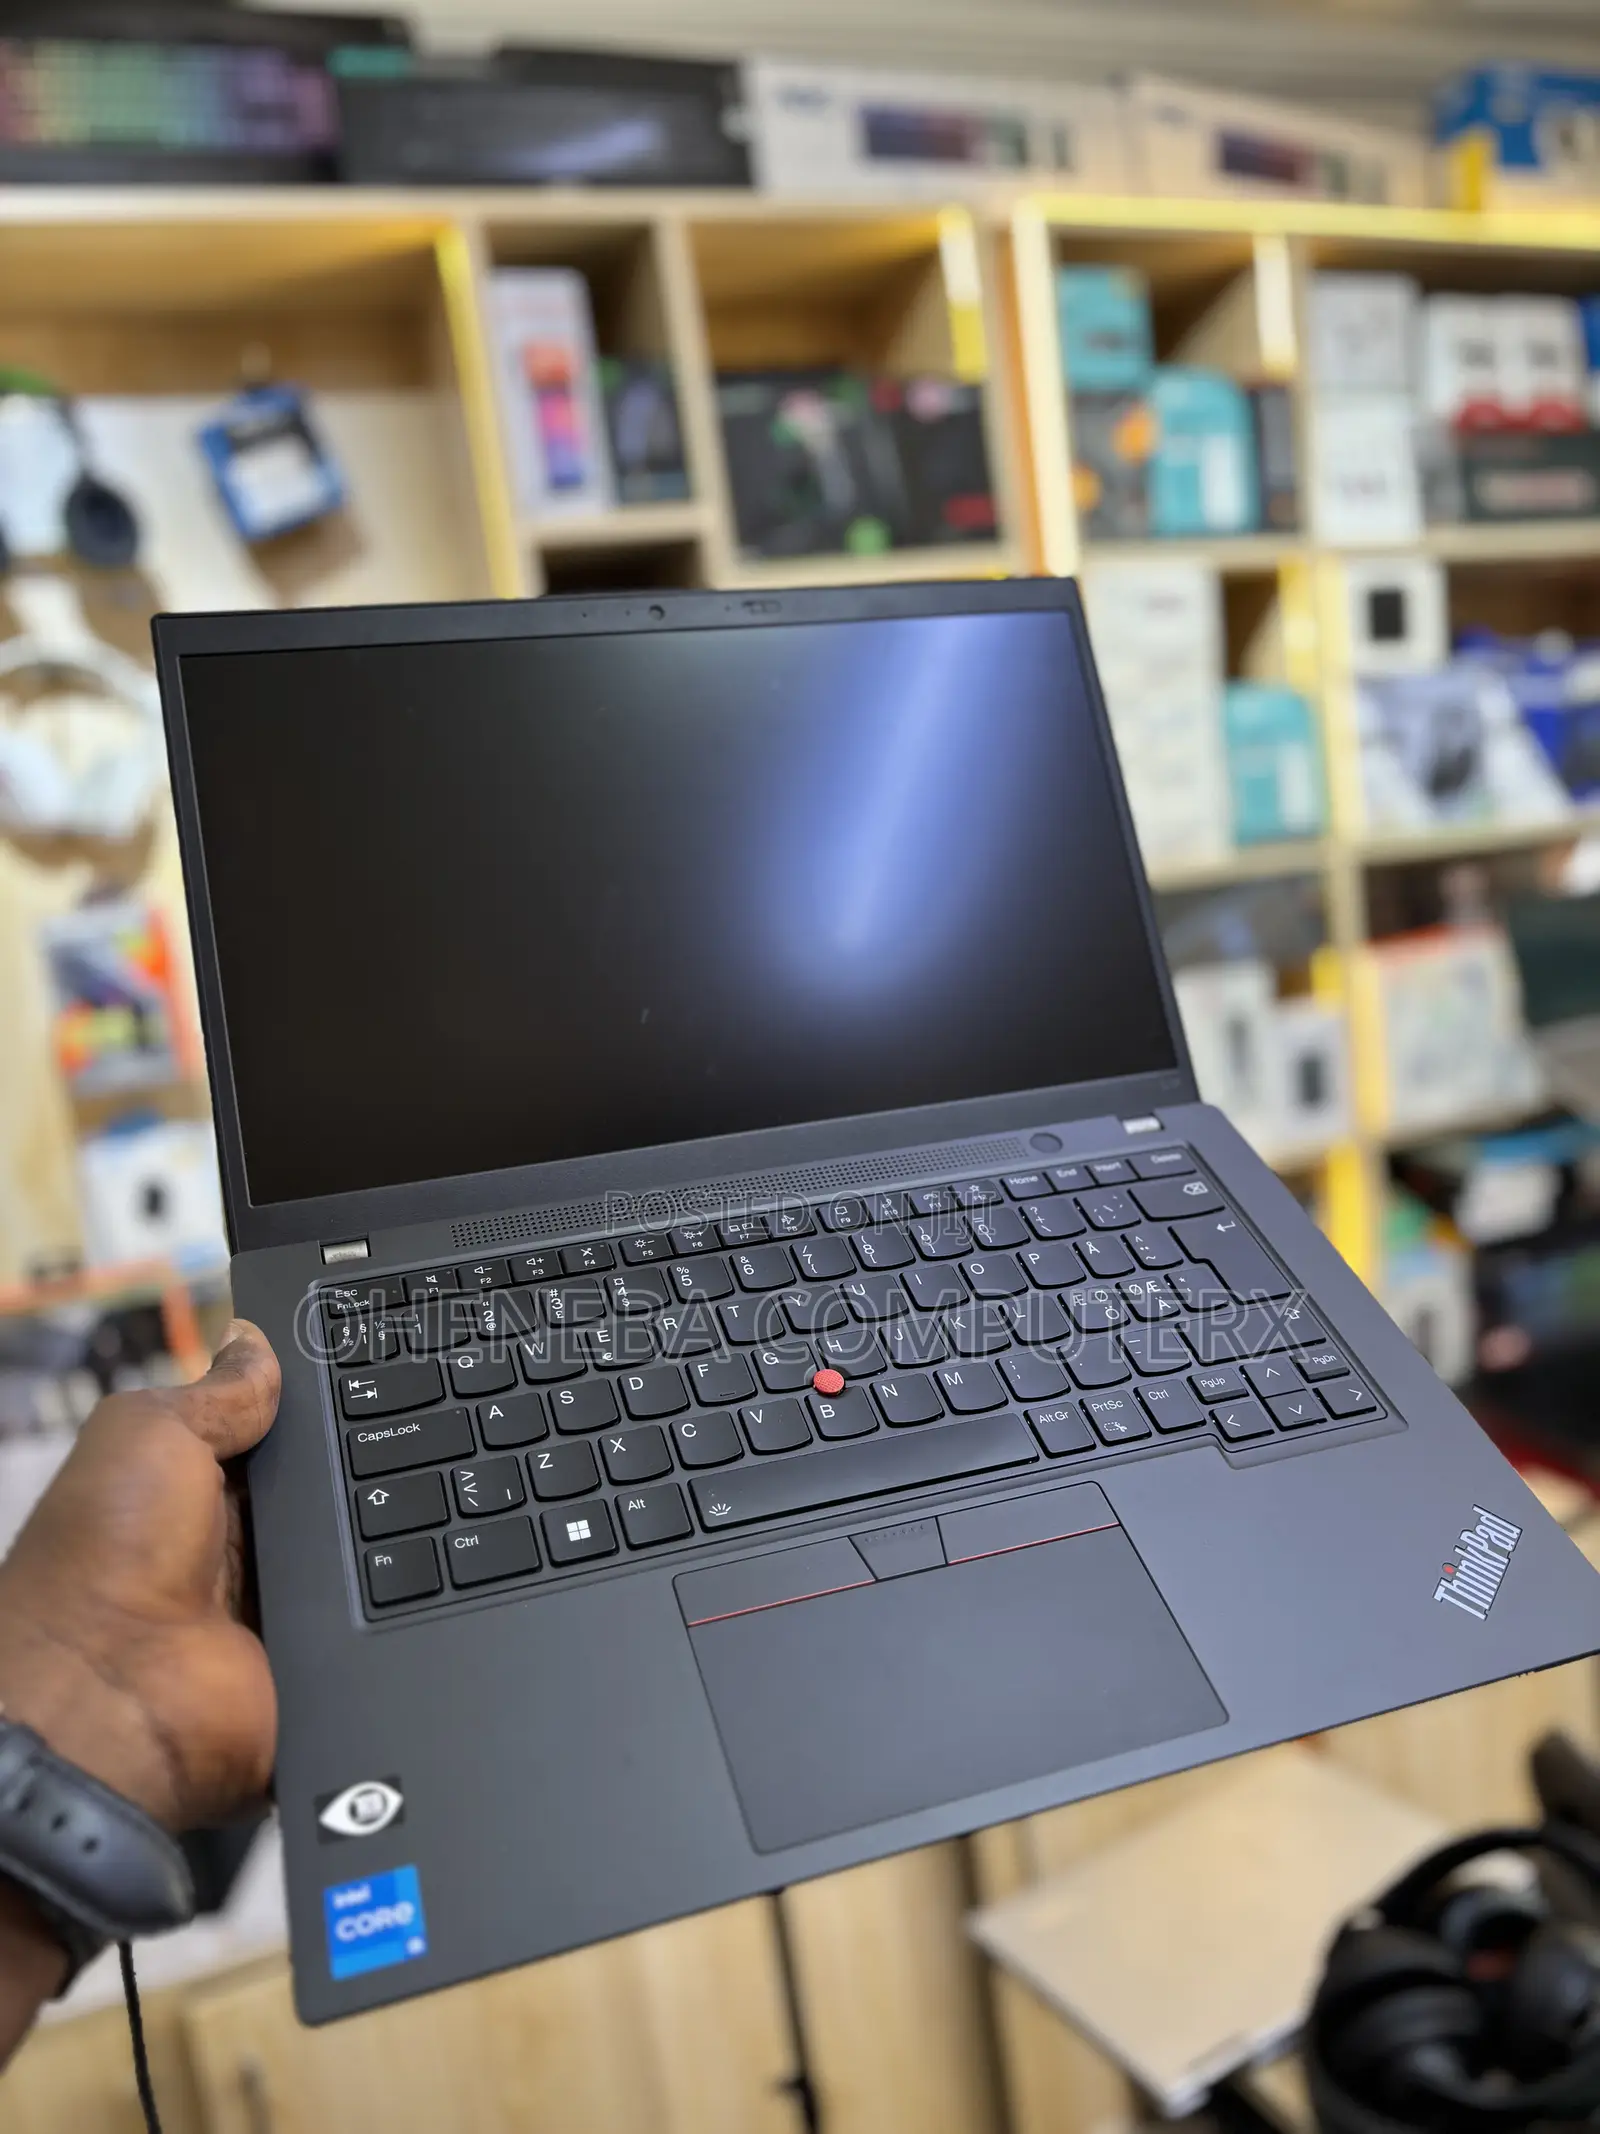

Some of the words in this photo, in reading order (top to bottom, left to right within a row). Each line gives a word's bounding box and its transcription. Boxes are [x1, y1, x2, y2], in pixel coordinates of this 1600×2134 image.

[1008, 1175, 1039, 1186] Home
[970, 1263, 985, 1275] O
[335, 1289, 358, 1299] Esc
[336, 1299, 370, 1310] FnLock
[525, 1341, 544, 1356] W
[457, 1355, 474, 1369] Q
[763, 1352, 779, 1366] G
[1312, 1354, 1337, 1366] PgDn
[697, 1364, 709, 1379] F
[944, 1371, 963, 1386] M
[628, 1376, 644, 1391] D
[1200, 1376, 1226, 1389] PgUp
[560, 1390, 575, 1405] S
[882, 1383, 899, 1398] N
[1148, 1388, 1169, 1401] Ctrl
[488, 1405, 505, 1420] A
[819, 1404, 835, 1419] B
[1091, 1400, 1124, 1413] PrtSc
[750, 1410, 763, 1425] V
[357, 1422, 421, 1443] CapsLock
[681, 1423, 697, 1438] C
[609, 1437, 626, 1453] X
[538, 1453, 554, 1470] Z
[628, 1499, 646, 1511] Alt
[454, 1535, 479, 1549] Ctrl
[374, 1554, 393, 1567] Fn
[1432, 1503, 1522, 1621] ThinkPad
